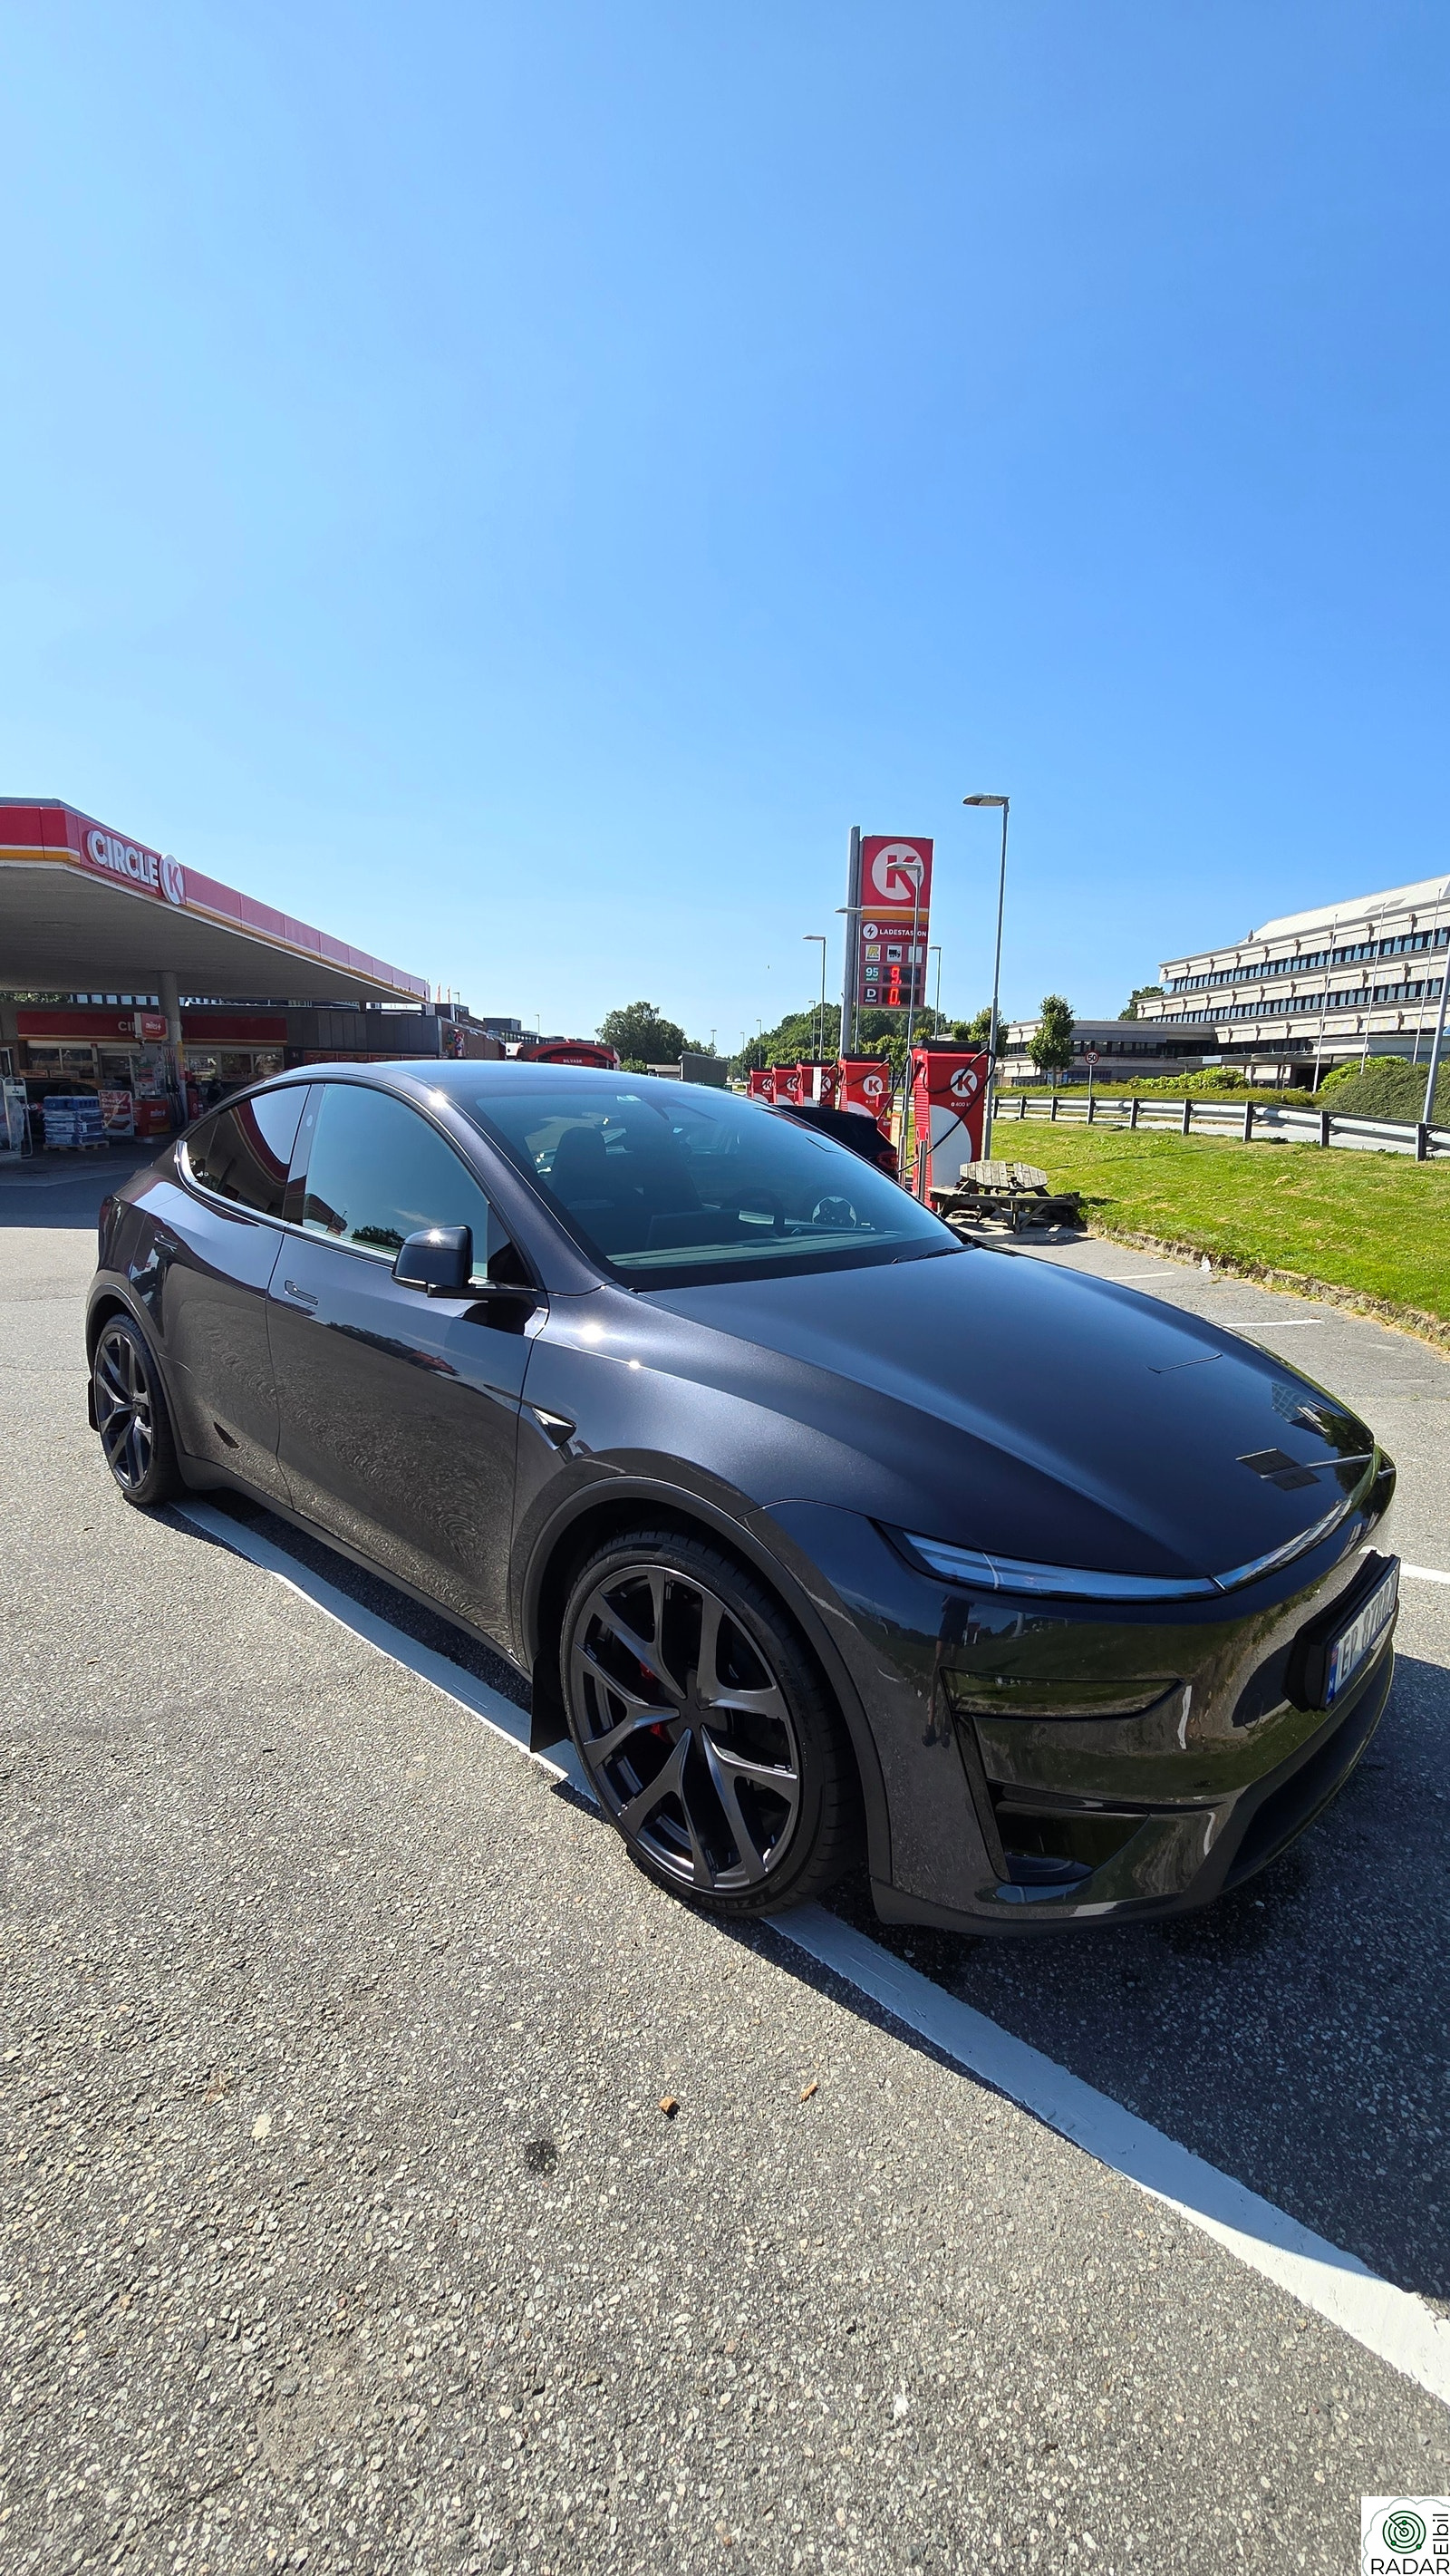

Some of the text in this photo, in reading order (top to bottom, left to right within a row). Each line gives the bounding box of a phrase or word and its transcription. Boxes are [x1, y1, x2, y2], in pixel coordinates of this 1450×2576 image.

[88, 830, 186, 905] CIRCLE K
[882, 851, 921, 899] K
[879, 928, 927, 937] LADESTASON
[865, 967, 879, 977] 95
[866, 988, 876, 998] D
[866, 1078, 882, 1095] K
[955, 1072, 975, 1096] K
